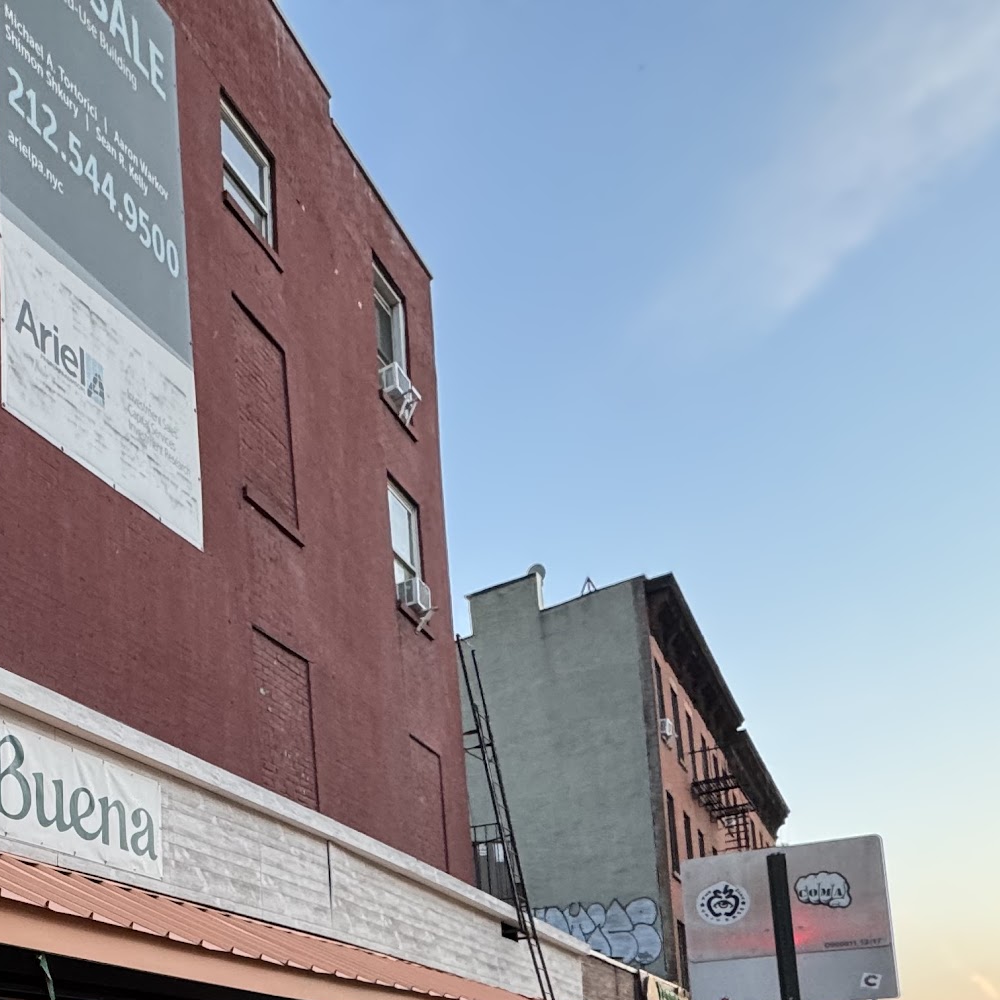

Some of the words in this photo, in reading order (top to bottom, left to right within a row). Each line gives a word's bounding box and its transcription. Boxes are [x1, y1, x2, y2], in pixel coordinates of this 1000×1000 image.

[4, 5, 44, 60] Michael
[46, 53, 56, 74] A.
[58, 65, 98, 120] Tortorici
[113, 130, 139, 162] Aaron
[139, 157, 169, 201] Warkov
[5, 25, 44, 79] Shimon
[46, 70, 79, 119] Shkury
[96, 126, 117, 158] Sean
[128, 162, 149, 197] Kelly
[100, 31, 137, 91] Building
[7, 129, 64, 195] arielpa.nyc
[7, 66, 180, 278] 212.544.9500
[14, 299, 86, 387] Ariel
